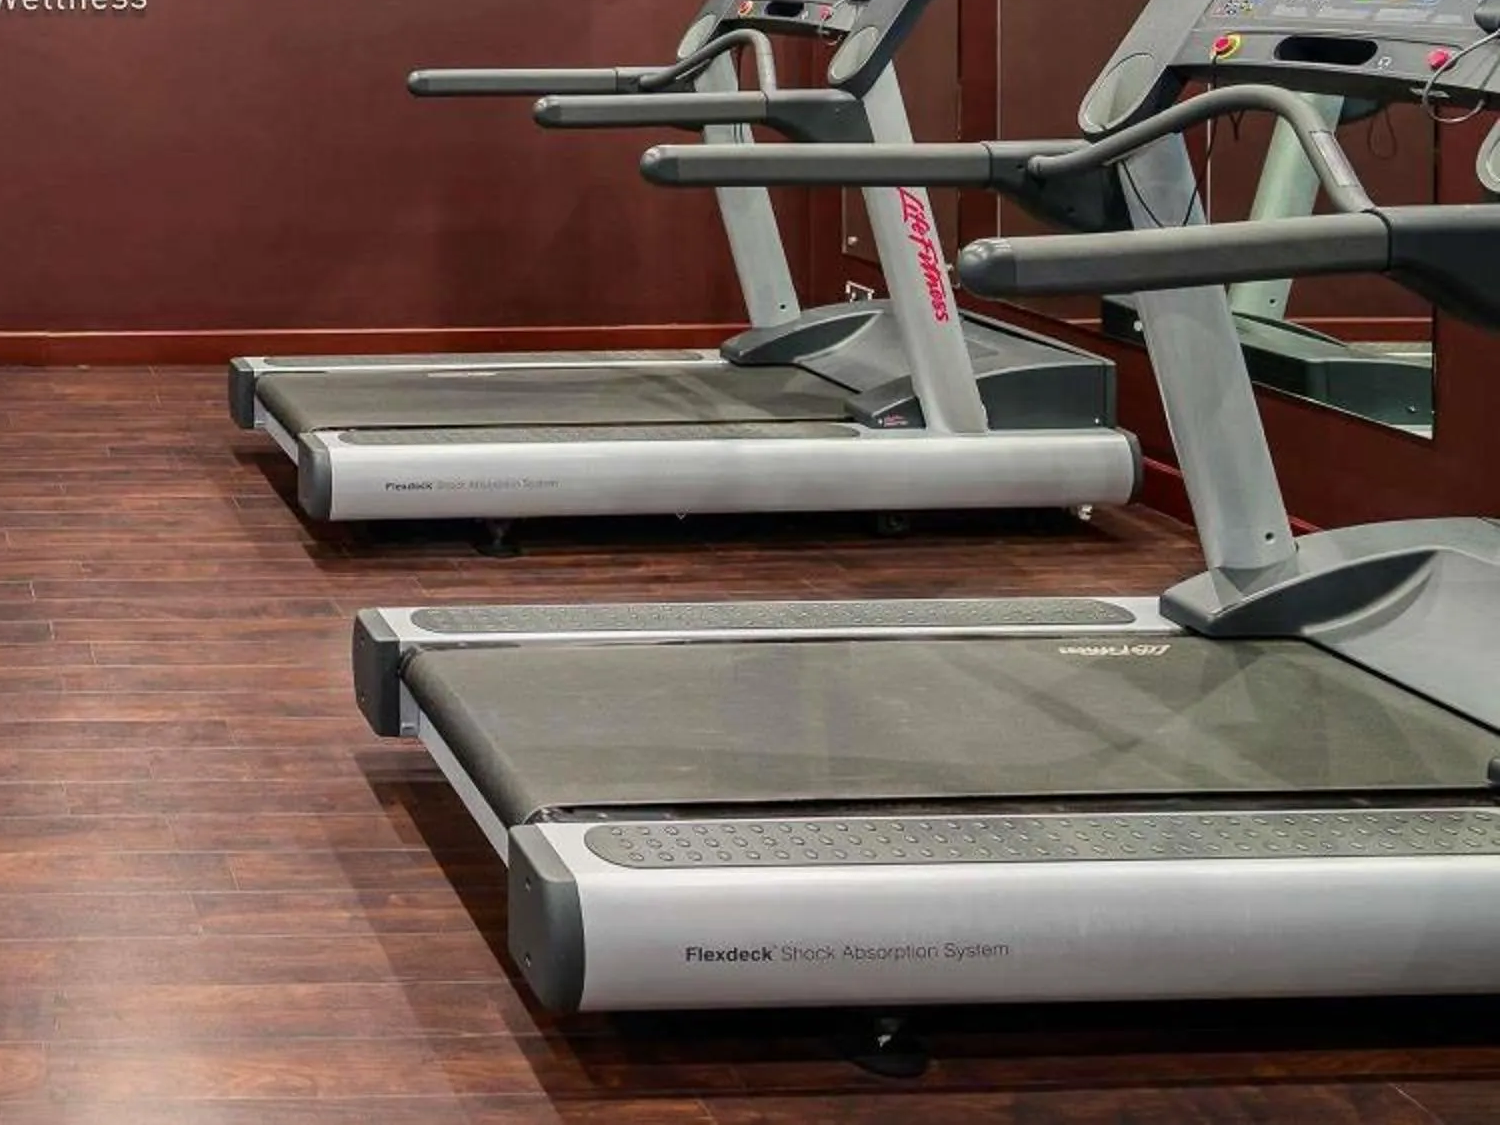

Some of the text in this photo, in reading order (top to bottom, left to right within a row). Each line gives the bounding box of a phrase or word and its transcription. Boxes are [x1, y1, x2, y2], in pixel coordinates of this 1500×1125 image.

[685, 941, 1010, 963] Flexdeck Shock Absorption System
